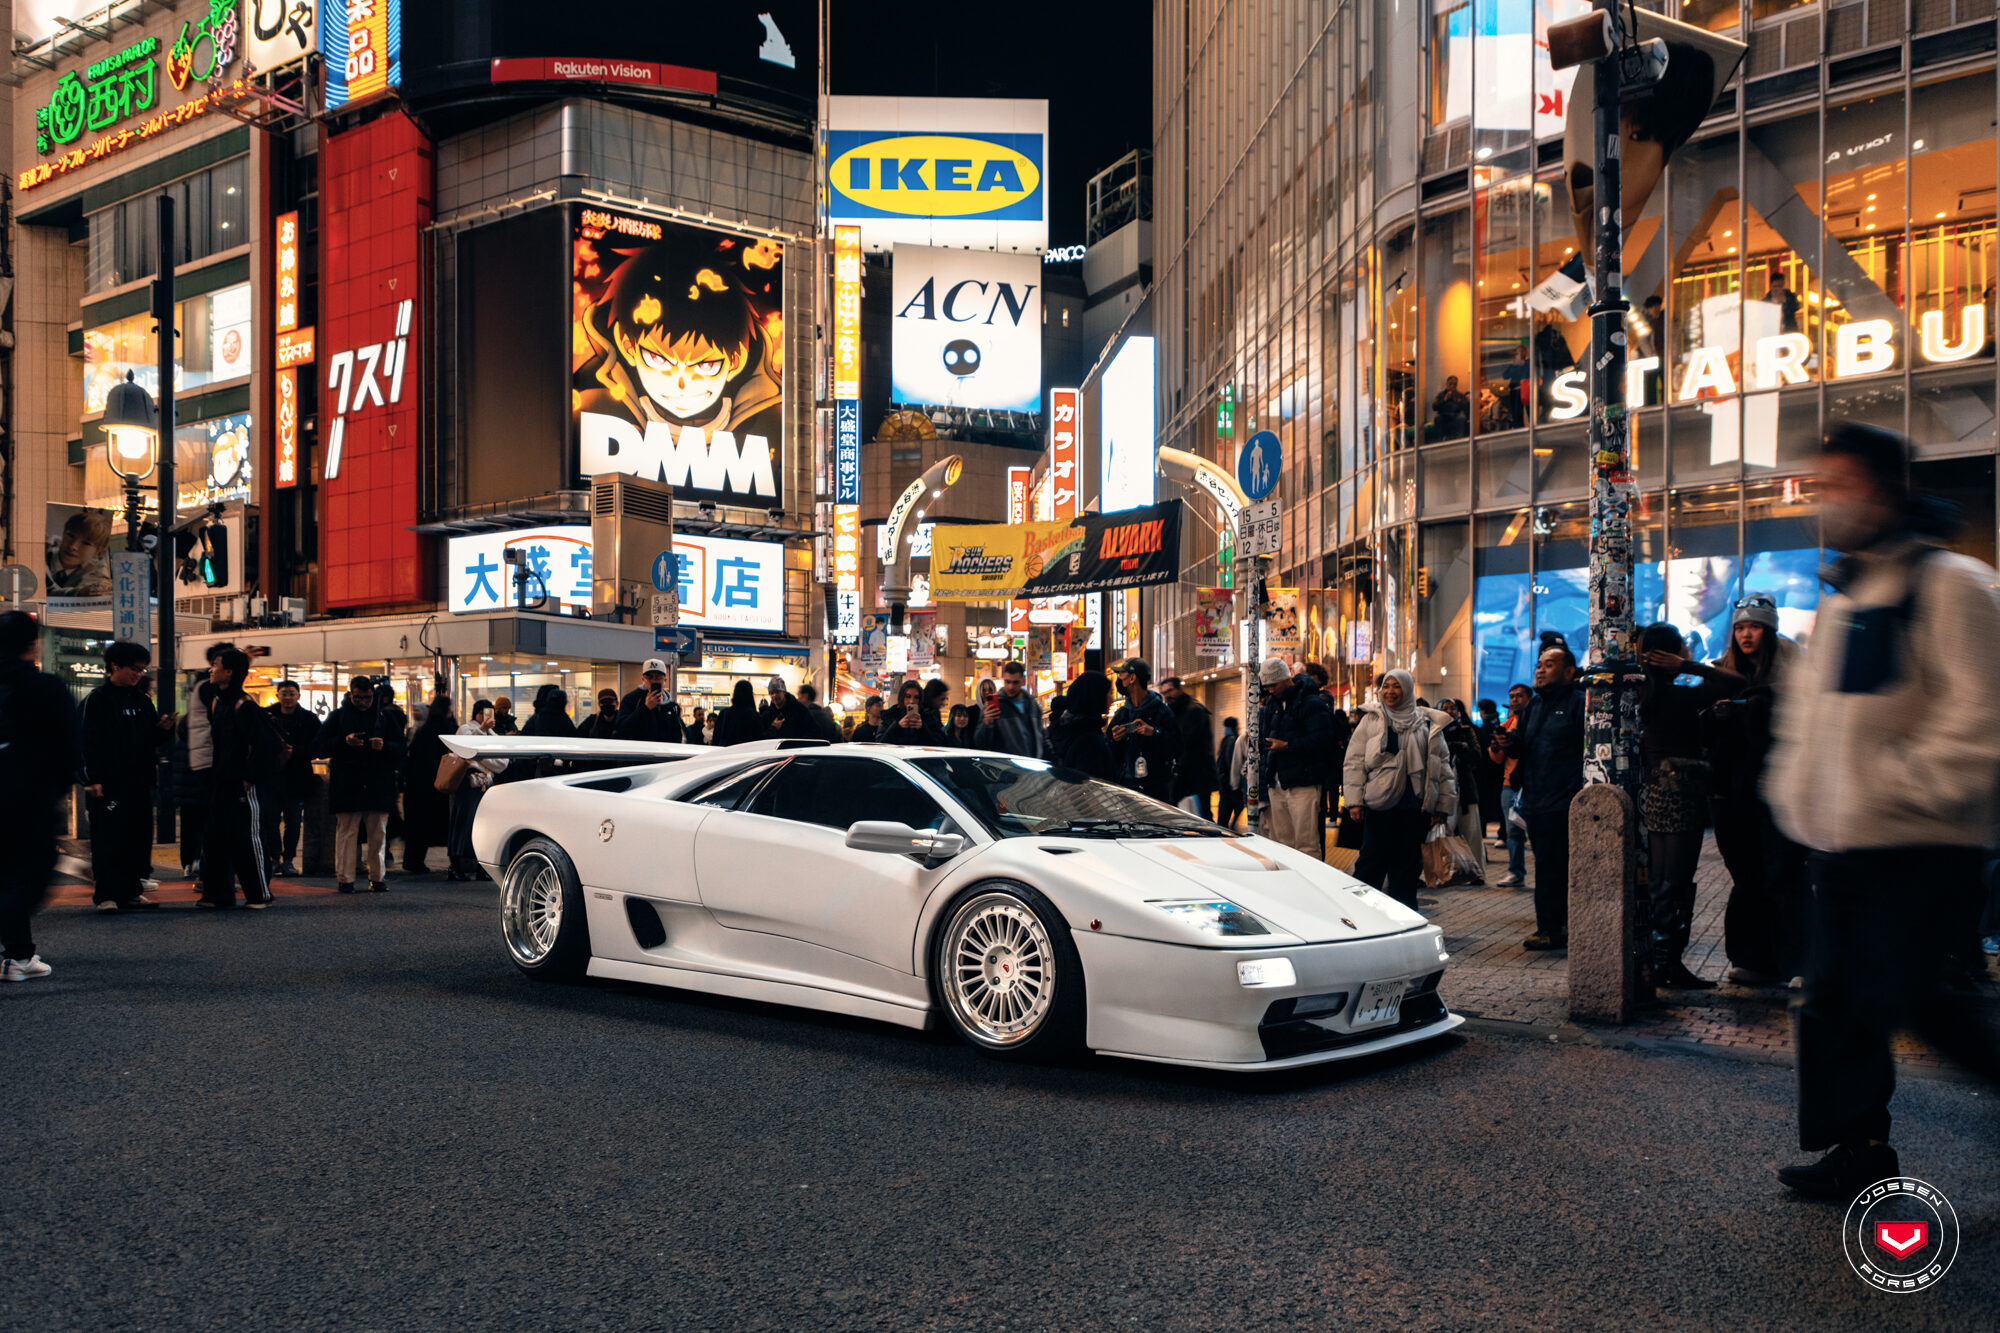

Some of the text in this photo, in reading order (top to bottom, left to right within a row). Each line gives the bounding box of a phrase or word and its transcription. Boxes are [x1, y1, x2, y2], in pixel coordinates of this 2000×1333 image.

[87, 57, 155, 131] 西村
[554, 62, 651, 79] Rakuten Vision
[850, 157, 1025, 192] IKEA
[1044, 244, 1087, 263] PARCO
[896, 276, 1038, 327] ACN
[328, 336, 407, 415] クスリ
[1551, 303, 1985, 419] STARBU
[580, 411, 776, 497] DMM
[840, 405, 856, 499] 大盛堂商事ビル
[1054, 404, 1075, 506] カラオケ
[885, 483, 920, 562] 渋谷センター街
[1099, 519, 1165, 559] ALVARK
[1242, 510, 1251, 523] 15
[1271, 503, 1277, 516] 5
[940, 546, 1014, 574] ROCKERS
[1242, 541, 1251, 555] 12
[1271, 535, 1277, 548] 5
[120, 561, 135, 640] 文化村通り
